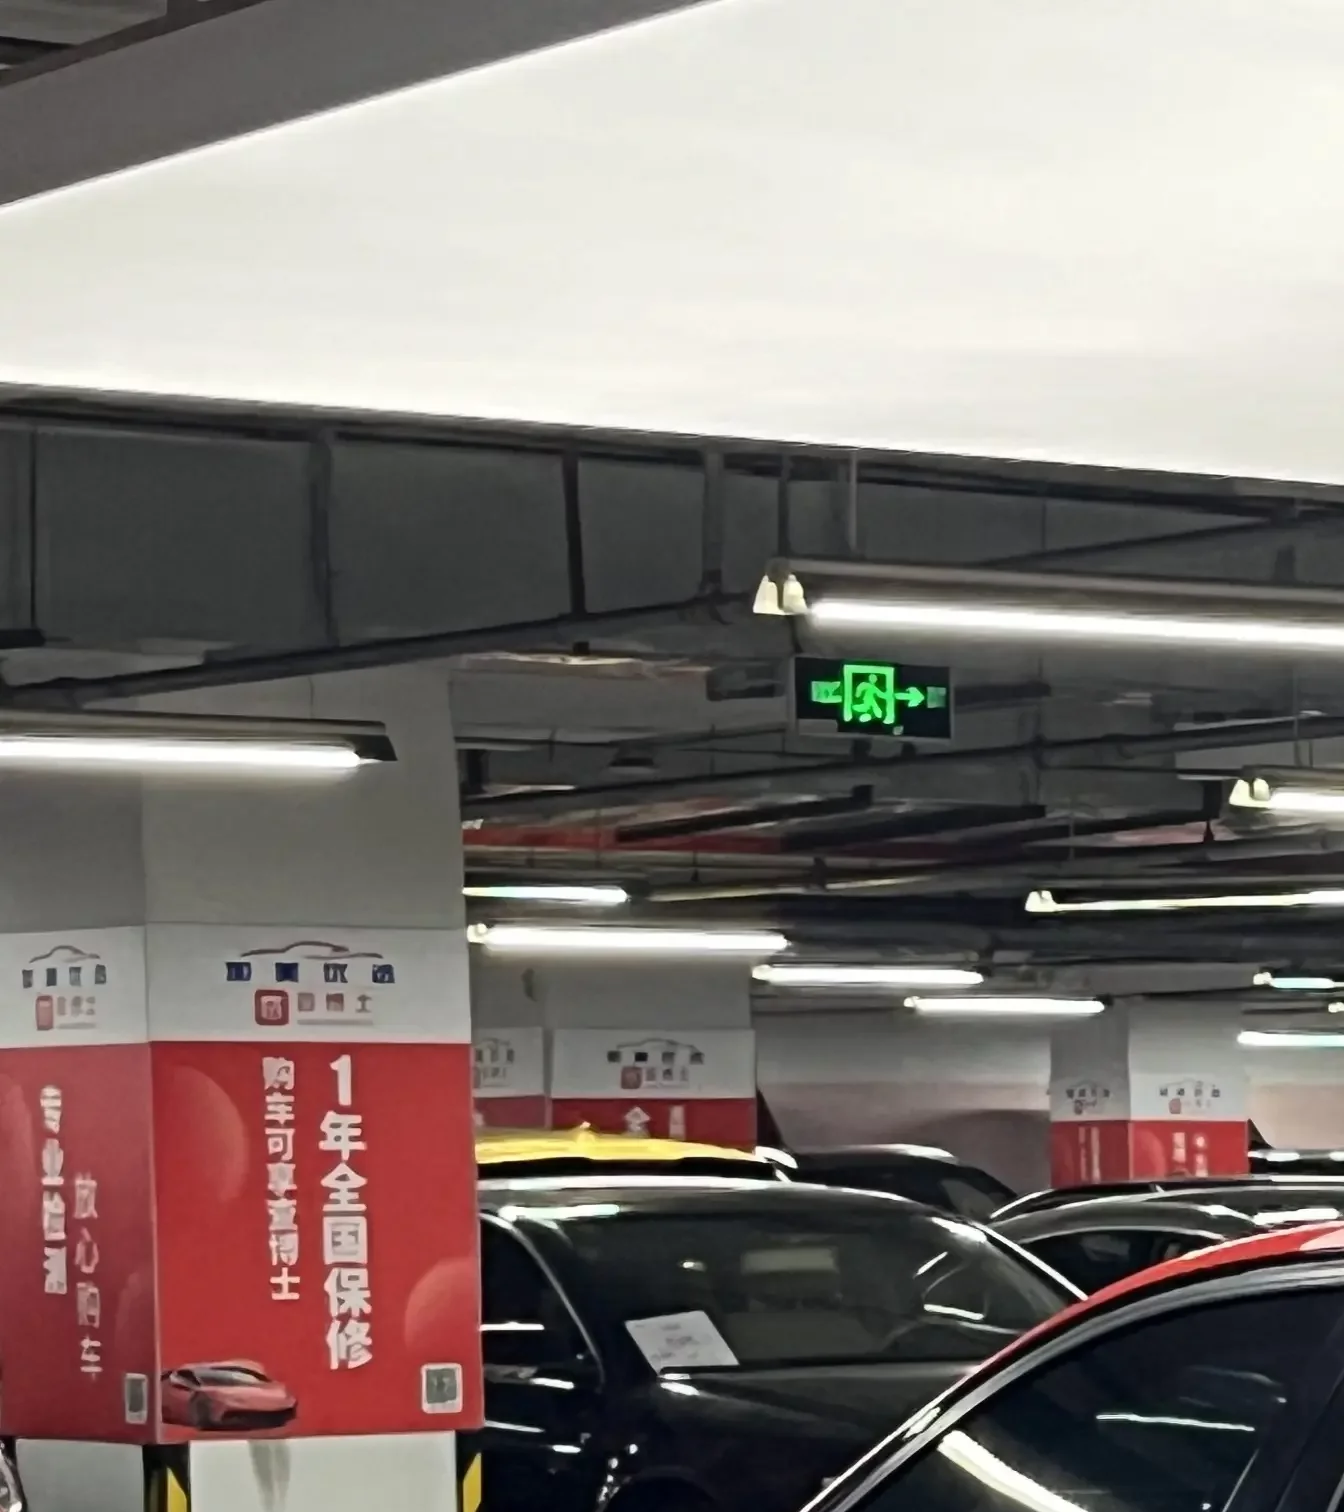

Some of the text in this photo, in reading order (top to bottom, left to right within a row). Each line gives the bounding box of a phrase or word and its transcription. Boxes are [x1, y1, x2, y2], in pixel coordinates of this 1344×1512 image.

[318, 1054, 374, 1371] 1年全国保修
